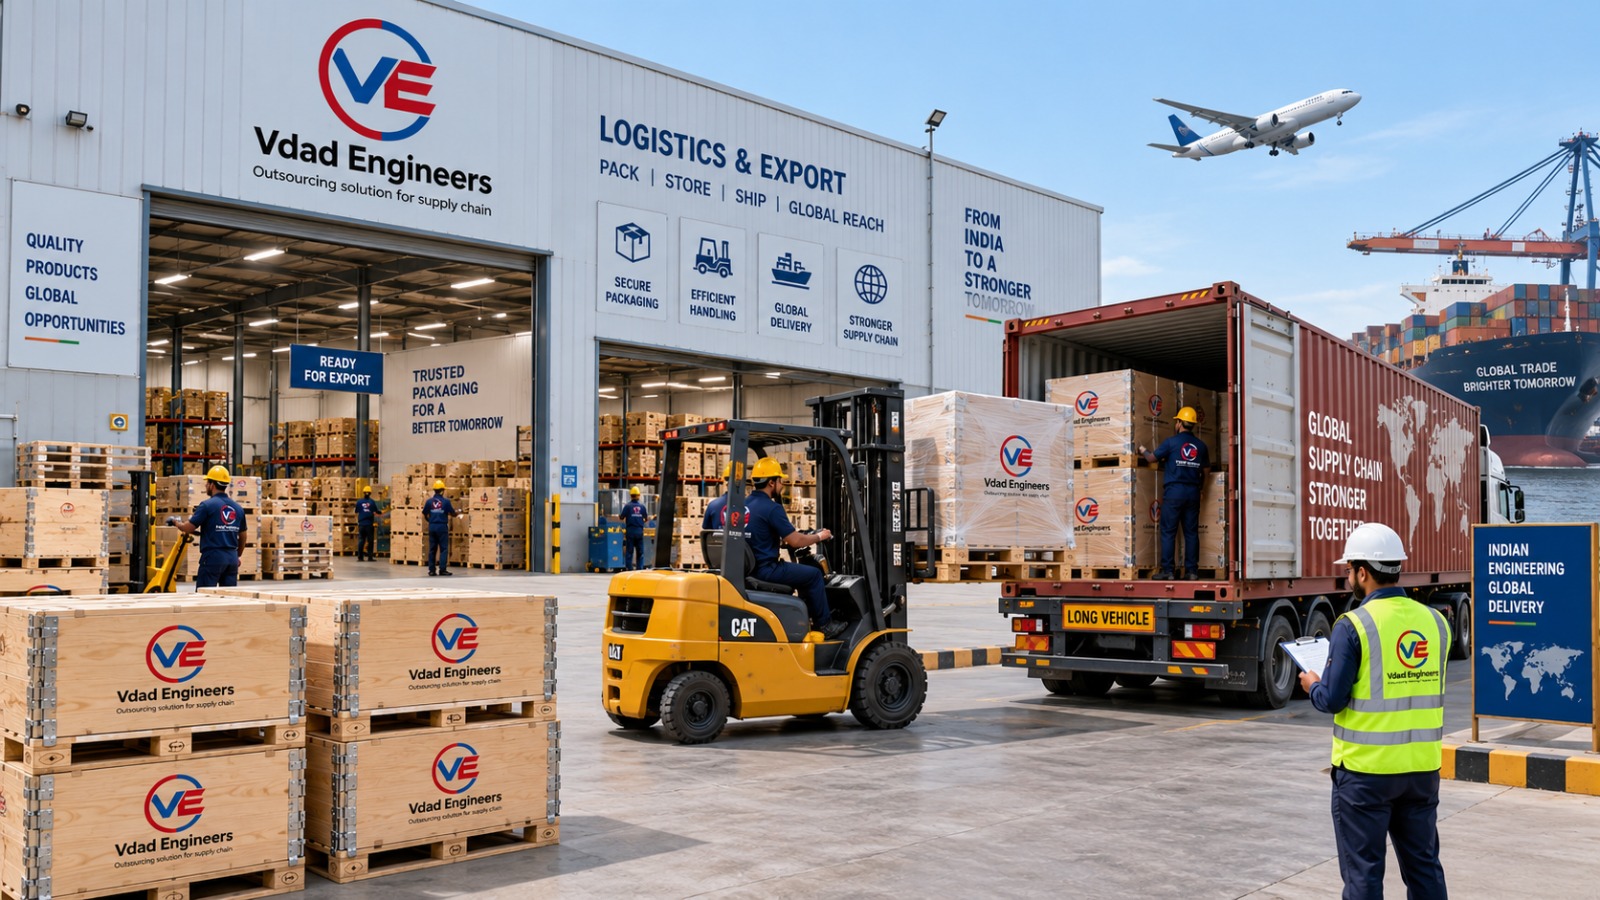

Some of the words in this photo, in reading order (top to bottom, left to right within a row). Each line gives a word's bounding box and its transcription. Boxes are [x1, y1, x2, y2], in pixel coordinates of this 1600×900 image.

[254, 126, 338, 168] Vdad
[348, 144, 492, 194] Engineers
[600, 114, 726, 168] LOGISTICS
[734, 148, 752, 175] &
[760, 153, 846, 196] EXPORT
[252, 165, 337, 192] Outsourcing
[341, 181, 392, 200] solution
[396, 190, 415, 203] for
[418, 196, 458, 213] supply
[461, 202, 492, 216] chain
[600, 158, 639, 182] PACK
[665, 172, 711, 197] STORE
[735, 189, 767, 208] SHIP
[788, 200, 840, 225] GLOBAL
[842, 210, 885, 233] REACH
[965, 207, 1001, 230] FROM
[26, 232, 84, 254] QUALITY
[965, 229, 1004, 253] INDIA
[26, 259, 98, 281] PRODUCTS
[965, 250, 983, 269] TO
[987, 254, 997, 272] A
[614, 275, 651, 293] SECURE
[964, 271, 1031, 300] STRONGER
[25, 285, 78, 305] GLOBAL
[605, 291, 659, 310] PACKAGING
[691, 288, 736, 305] EFFICIENT
[965, 291, 1035, 318] TOMORROW
[690, 304, 736, 322] HANDLING
[774, 302, 808, 318] GLOBAL
[25, 312, 126, 336] OPPORTUNITIES
[770, 317, 812, 334] DELIVERY
[849, 314, 893, 332] STRONGER
[843, 327, 873, 345] SUPPLY
[874, 331, 898, 347] CHAIN
[320, 356, 356, 370] READY
[1476, 364, 1517, 377] GLOBAL
[1520, 361, 1557, 375] TRADE
[304, 370, 326, 383] FOR
[329, 372, 371, 386] EXPORT
[413, 365, 465, 382] TRUSTED
[413, 381, 478, 400] PACKAGING
[1463, 379, 1511, 392] BRIGHTER
[1513, 376, 1576, 390] TOMORROW
[412, 403, 434, 416] FOR
[437, 402, 446, 415] A
[412, 421, 445, 434] BETTER
[448, 416, 503, 432] TOMORROW
[1308, 410, 1352, 445] GLOBAL
[1004, 447, 1033, 466] VE
[1308, 447, 1351, 476] SUPPLY
[1354, 454, 1383, 483] CHAIN
[984, 478, 1007, 488] Vdad
[1009, 480, 1050, 491] Engineers
[1309, 481, 1367, 511] STRONGER
[1309, 516, 1364, 540] TOGETH
[1489, 543, 1530, 557] INDIAN
[1489, 561, 1565, 577] ENGINEERING
[1489, 580, 1535, 596] GLOBAL
[1489, 599, 1545, 615] DELIVERY
[731, 618, 757, 637] CAT
[1068, 610, 1097, 624] LONG
[1102, 610, 1150, 626] VEHICLE
[437, 627, 479, 650] VE
[153, 640, 207, 668] VE
[1400, 640, 1429, 659] VE
[409, 667, 441, 680] Vdad
[444, 666, 501, 679] Engineers
[117, 688, 157, 703] Vdad
[162, 685, 234, 701] Engineers
[116, 705, 156, 714] Outsourcing
[158, 702, 184, 711] solution
[196, 700, 217, 708] supply
[437, 755, 480, 782] VE
[151, 788, 206, 818] VE
[409, 799, 441, 814] Vdad
[445, 793, 502, 809] Engineers
[115, 839, 156, 856] Vdad
[161, 832, 233, 850] Engineers
[195, 848, 215, 857] supply
[216, 846, 233, 854] chain
